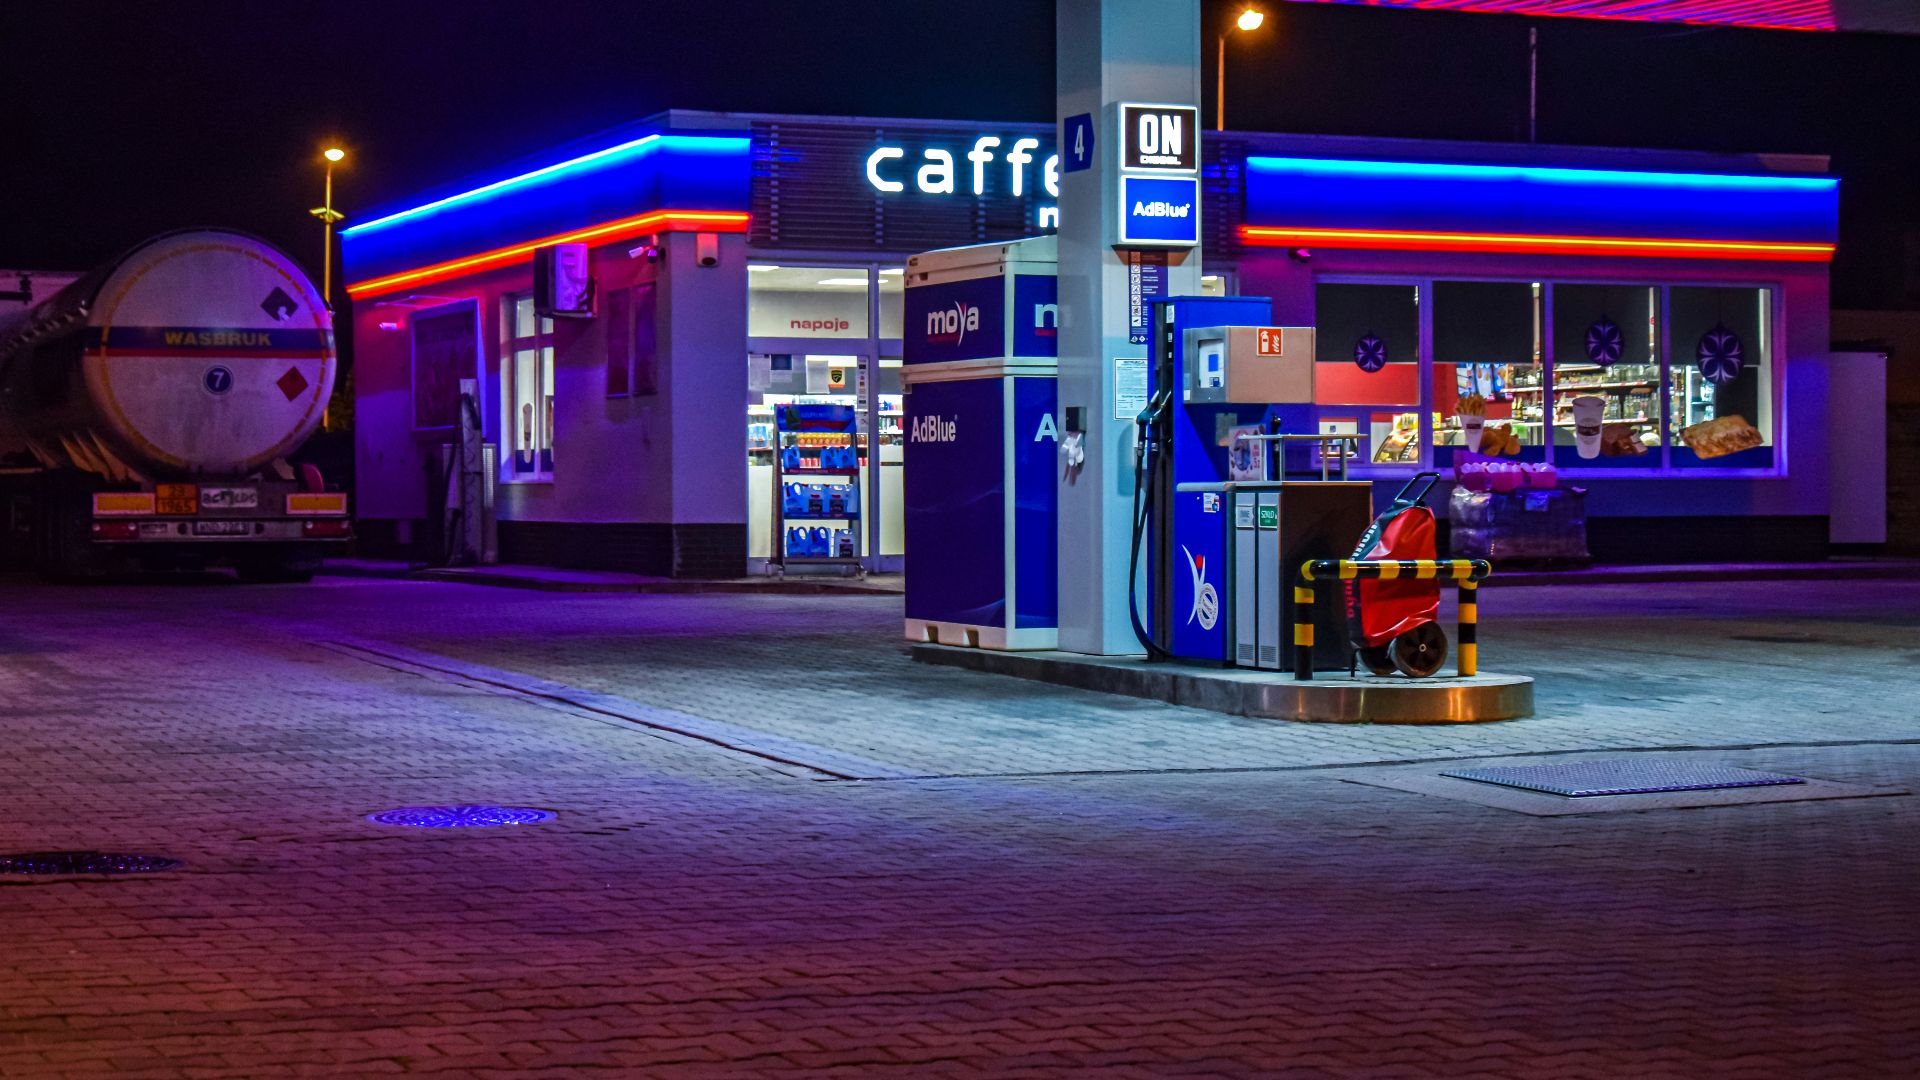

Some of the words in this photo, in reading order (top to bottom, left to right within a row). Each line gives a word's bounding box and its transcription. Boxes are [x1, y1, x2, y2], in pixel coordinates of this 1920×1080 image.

[1073, 124, 1085, 161] 4
[1139, 114, 1182, 155] ON
[790, 317, 849, 332] napoje
[927, 300, 980, 347] moya
[166, 333, 271, 346] WASBRUK
[214, 372, 223, 388] 7
[161, 499, 193, 513] 1965
